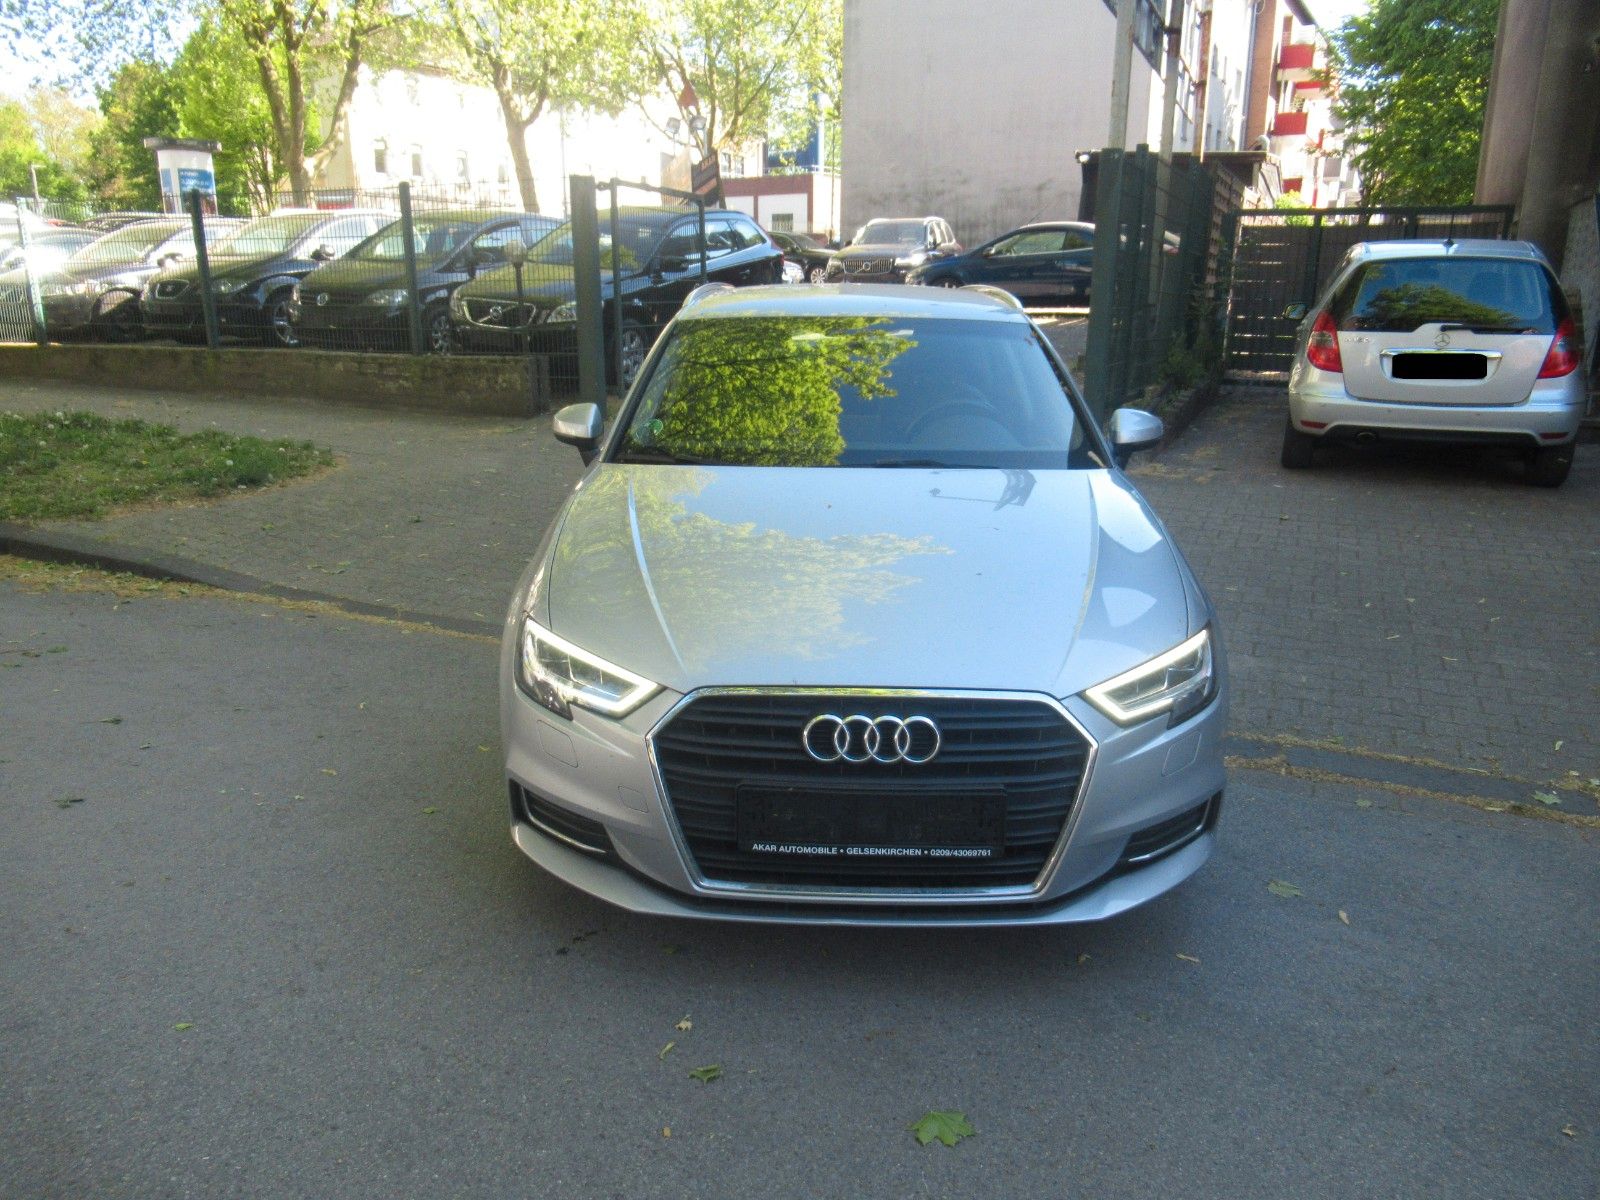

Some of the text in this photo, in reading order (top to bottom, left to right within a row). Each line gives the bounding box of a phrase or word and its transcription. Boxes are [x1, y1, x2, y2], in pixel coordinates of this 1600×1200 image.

[752, 843, 777, 852] AKAR
[779, 845, 838, 855] AUTOMOBILE
[846, 847, 922, 856] GELSENKIRCHEN
